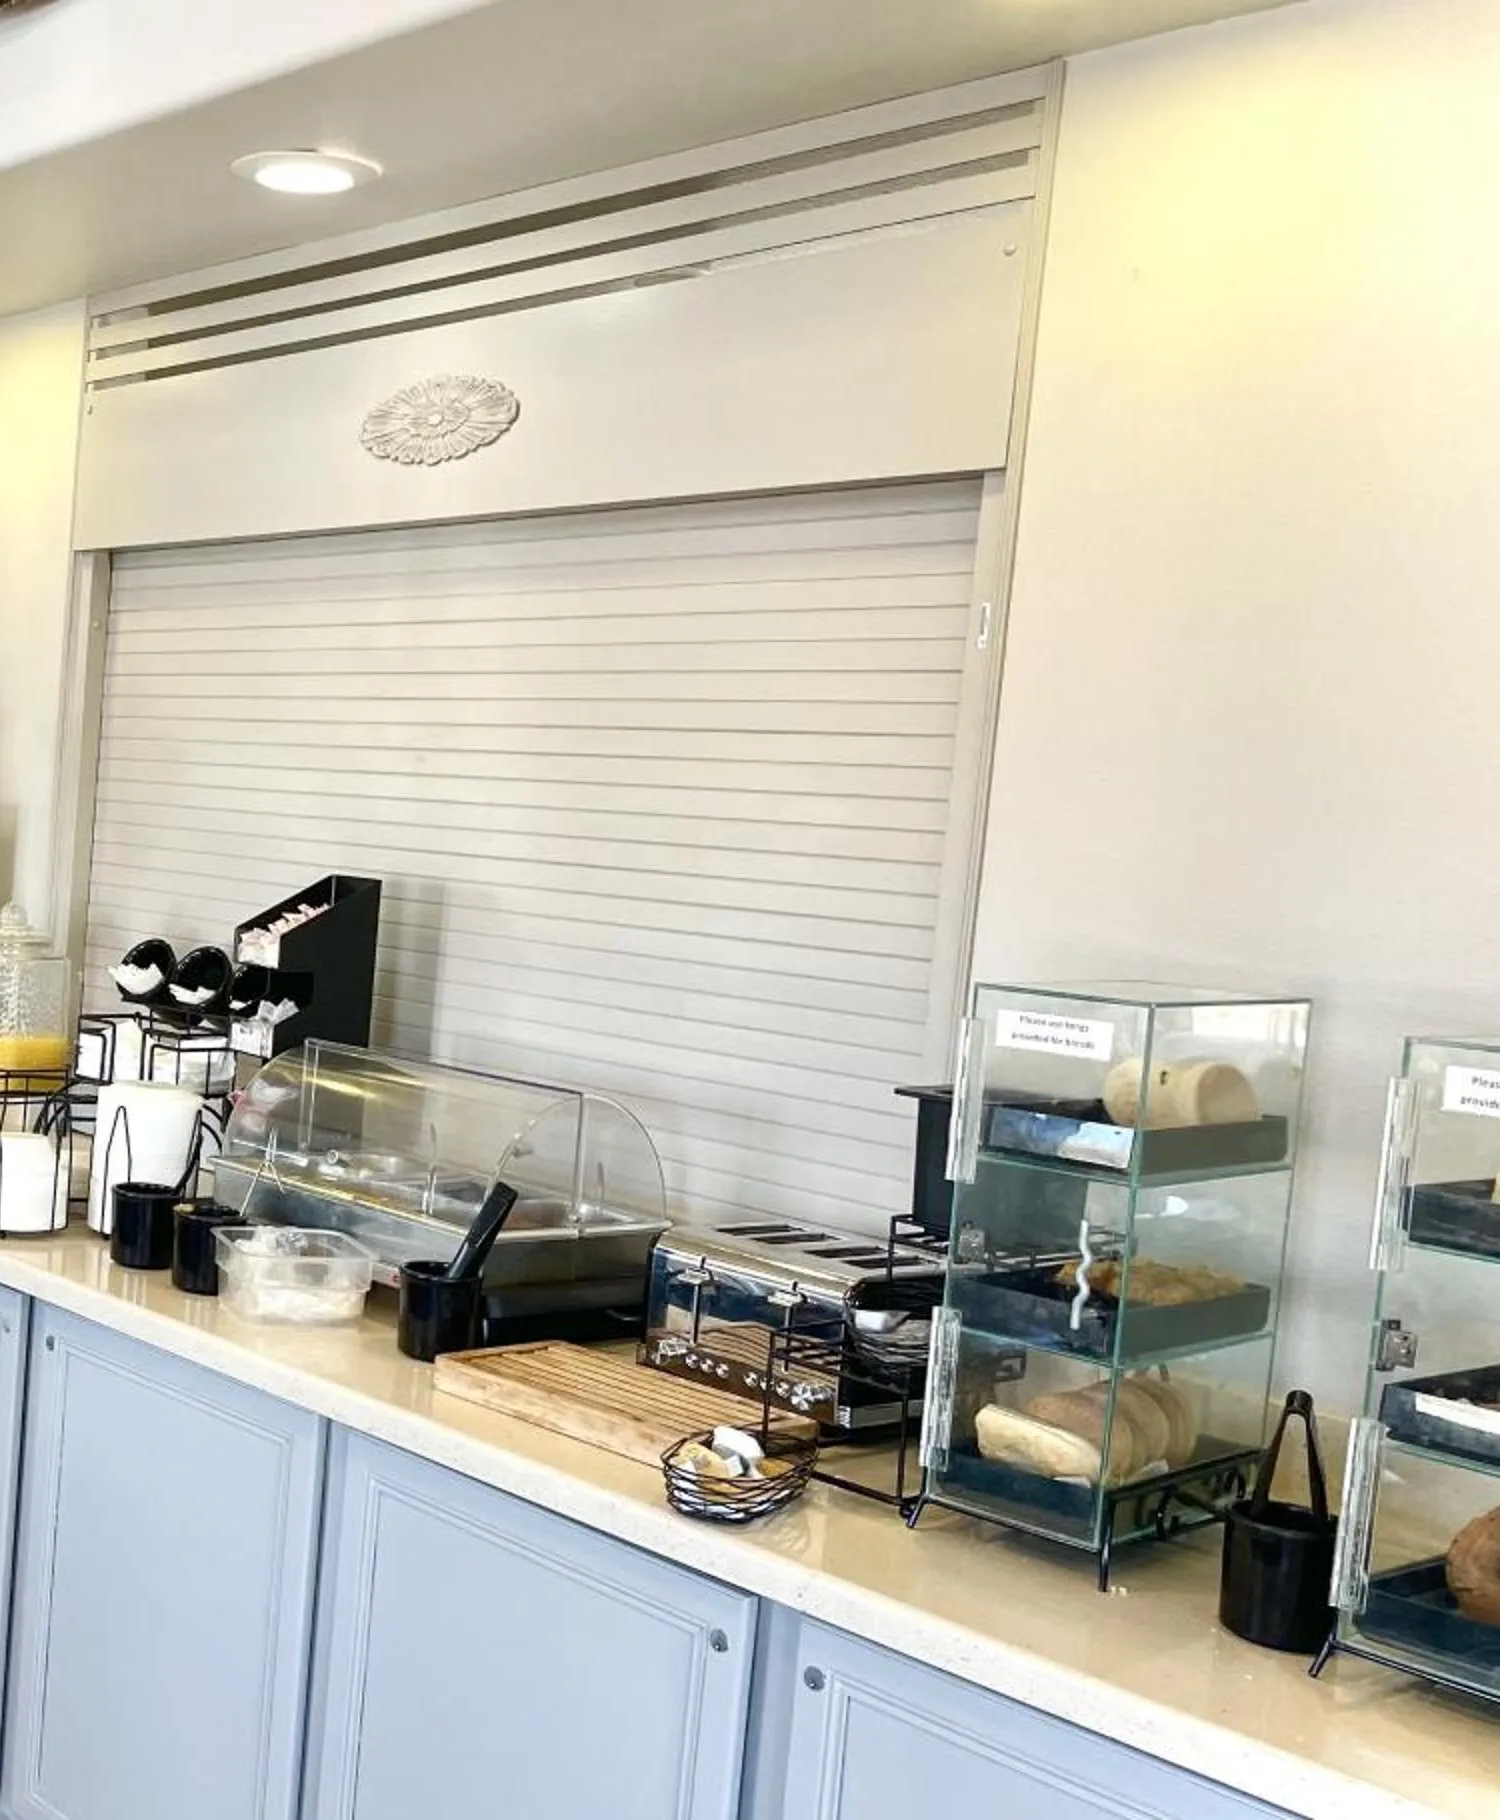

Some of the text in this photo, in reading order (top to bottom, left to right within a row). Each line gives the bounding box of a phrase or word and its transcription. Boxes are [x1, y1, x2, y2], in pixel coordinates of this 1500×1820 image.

[1019, 1015, 1047, 1026] Please
[1048, 1021, 1063, 1029] use
[1011, 1031, 1049, 1043] provided
[1051, 1036, 1063, 1045] for
[1460, 1096, 1500, 1109] provid
